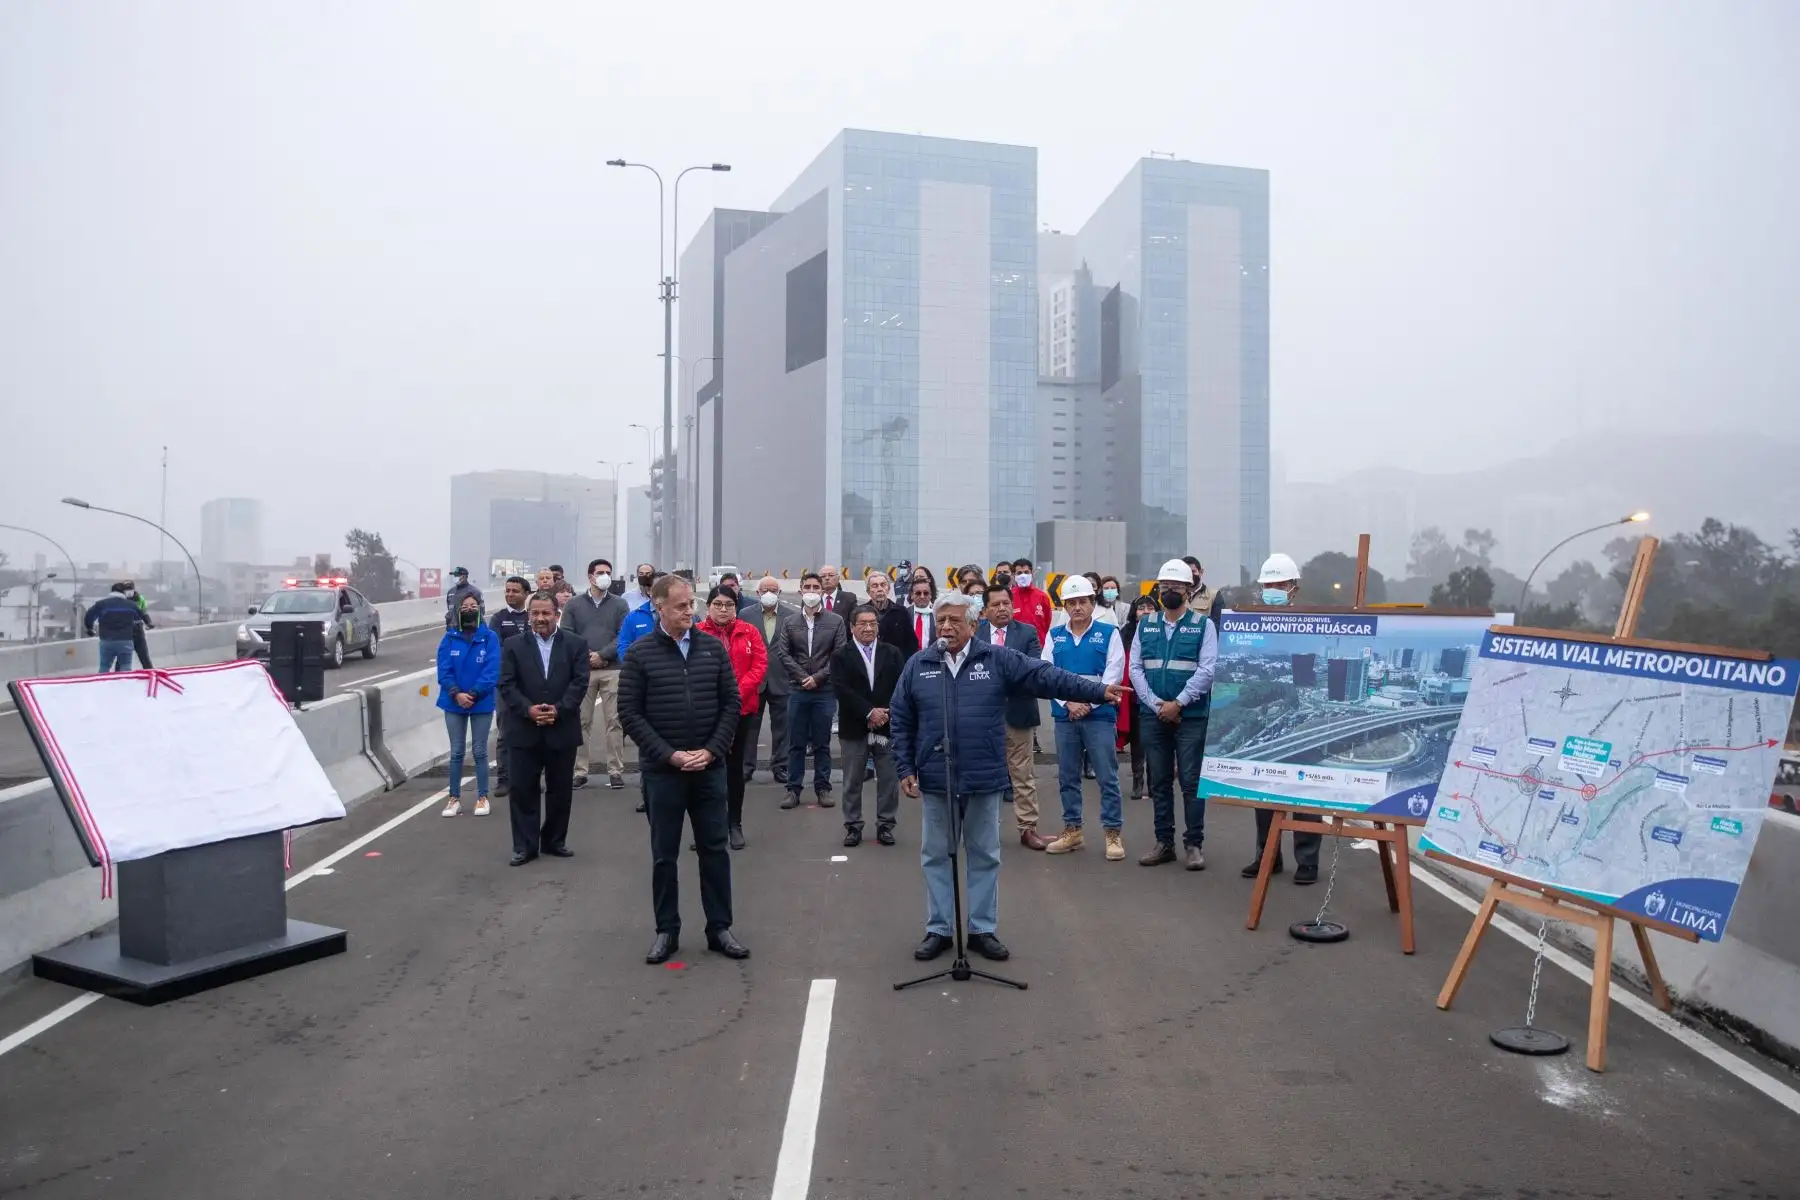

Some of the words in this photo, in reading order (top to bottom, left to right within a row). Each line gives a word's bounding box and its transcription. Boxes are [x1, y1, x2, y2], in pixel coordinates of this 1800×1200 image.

[1223, 619, 1259, 632] ÓVALO
[1261, 623, 1313, 633] MONITOR
[1315, 623, 1371, 635] HUÁSCAR
[1490, 637, 1557, 660] SISTEMA
[1562, 644, 1600, 665] VIAL
[1604, 649, 1786, 687] METROPOLITANO
[1670, 907, 1717, 936] LIMA
